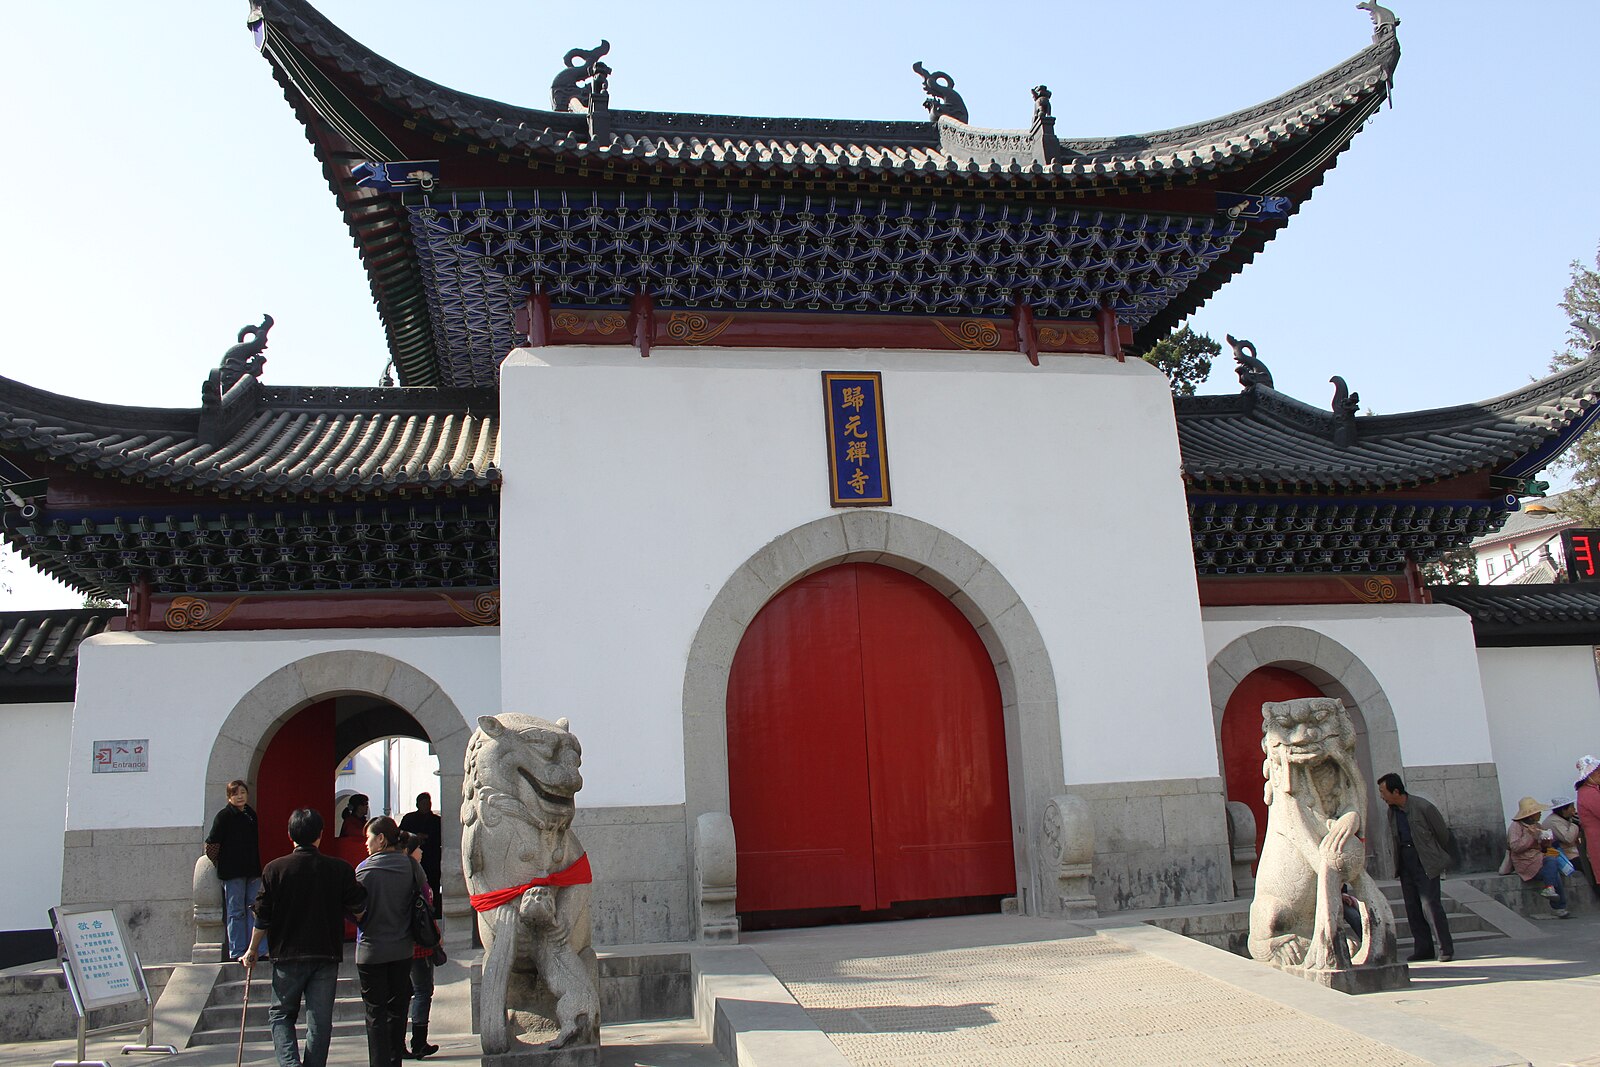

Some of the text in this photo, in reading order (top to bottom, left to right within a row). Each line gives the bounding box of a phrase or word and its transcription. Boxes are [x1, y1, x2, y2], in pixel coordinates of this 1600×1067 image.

[841, 386, 870, 494] 歸元禪寺
[116, 746, 144, 754] 入口
[112, 761, 146, 769] Entrance
[77, 920, 102, 930] 敬告
